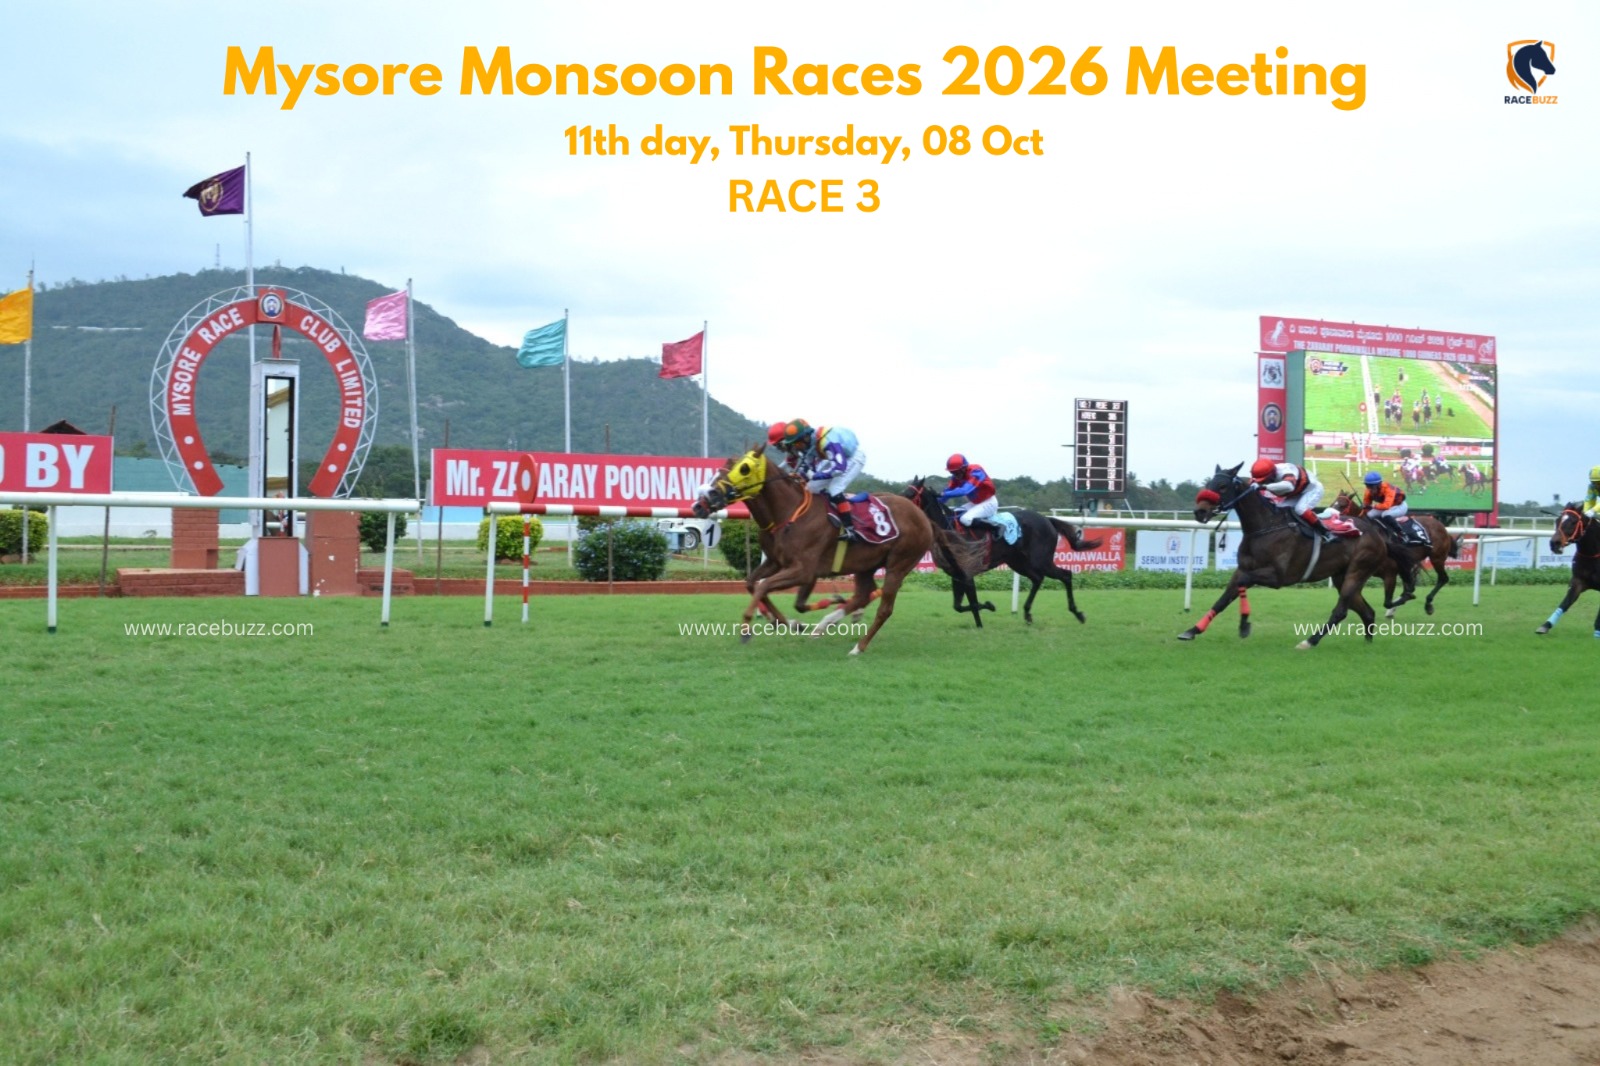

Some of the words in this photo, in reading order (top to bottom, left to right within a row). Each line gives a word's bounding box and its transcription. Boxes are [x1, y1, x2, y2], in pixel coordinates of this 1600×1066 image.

[172, 347, 202, 416] MYSORE
[198, 307, 244, 345] RACE
[299, 315, 342, 353] CLUB
[336, 358, 364, 429] LIMITED
[25, 443, 95, 489] BY
[446, 459, 485, 496] Mr.
[492, 461, 598, 500] ZAARAY
[705, 523, 716, 547] 1
[873, 511, 891, 536] 8
[1218, 532, 1227, 552] 4
[1053, 551, 1121, 562] POONAWALLA
[1141, 556, 1168, 565] SERUM
